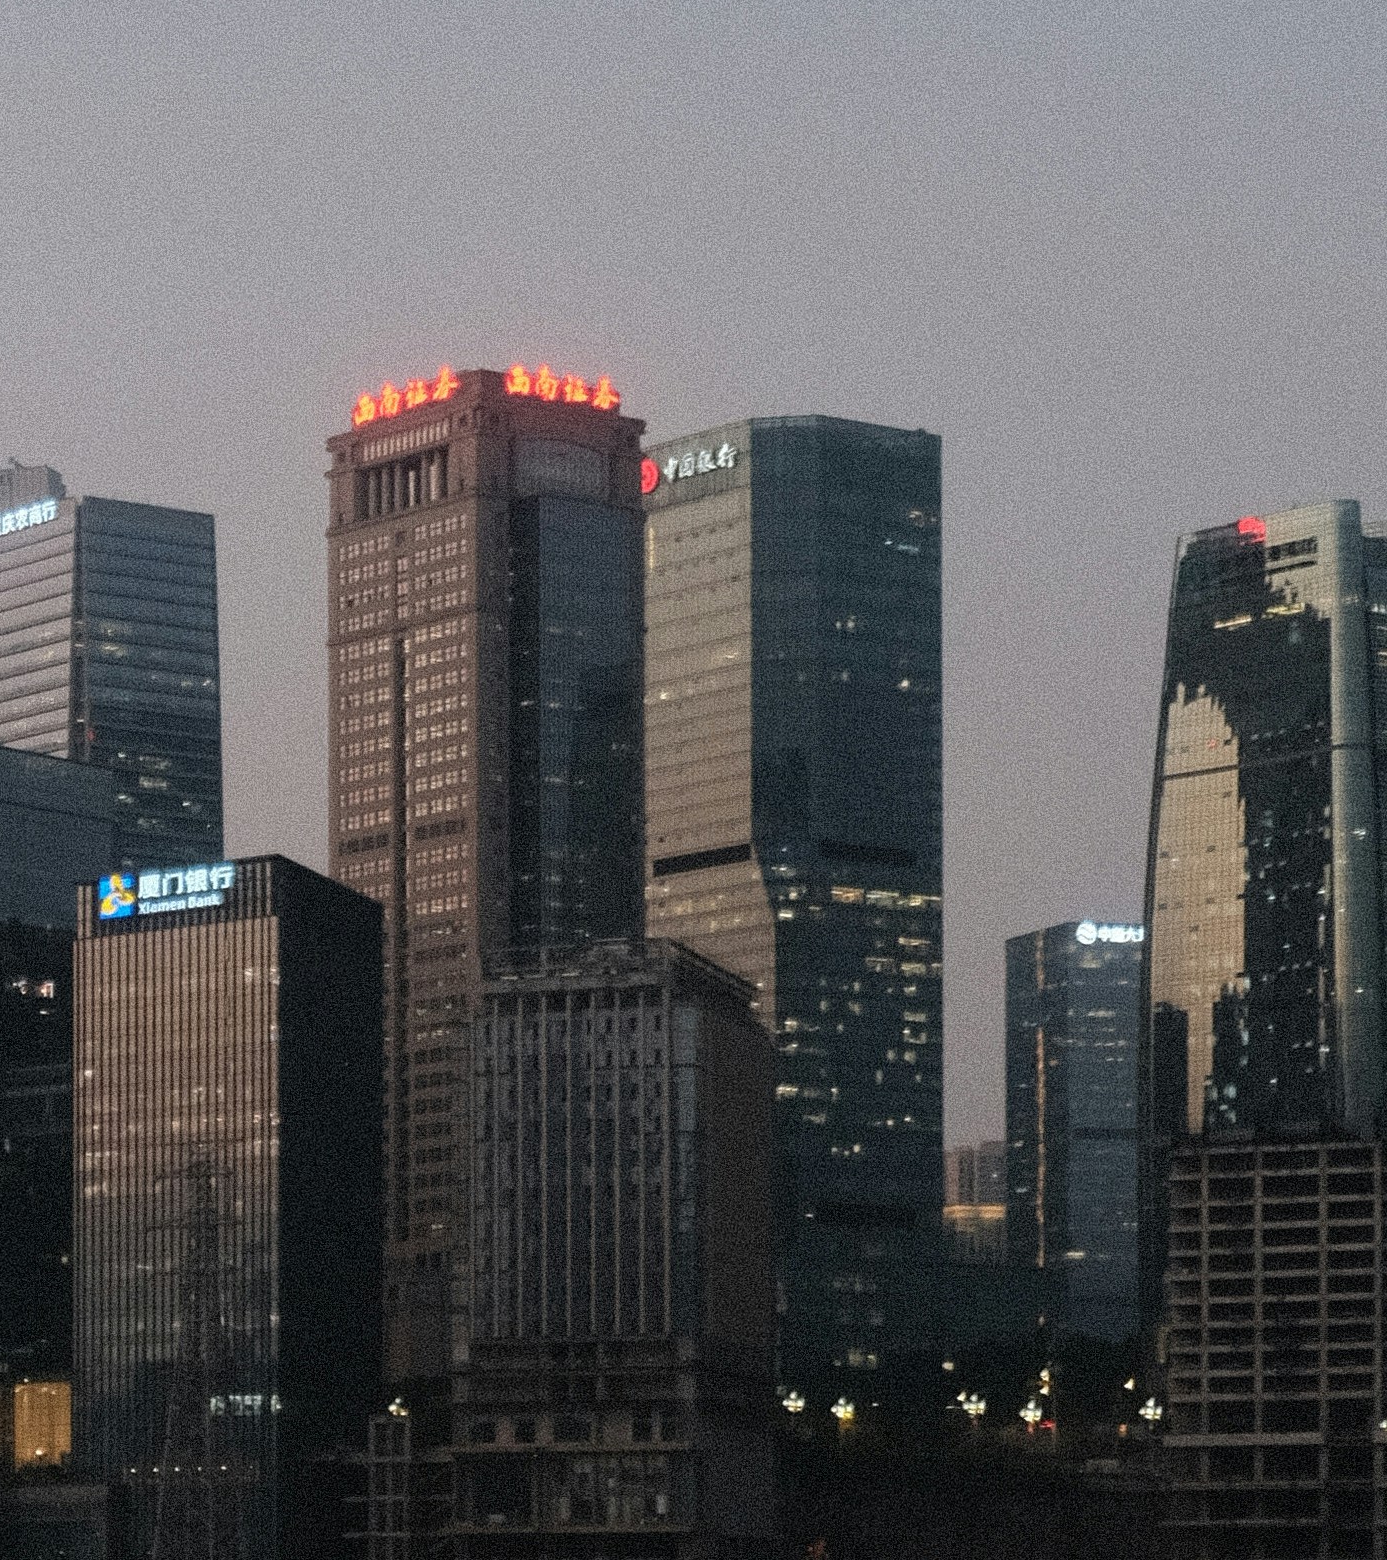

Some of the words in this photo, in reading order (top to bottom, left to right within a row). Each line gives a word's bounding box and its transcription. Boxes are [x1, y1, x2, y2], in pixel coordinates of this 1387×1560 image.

[138, 865, 233, 899] 厦门银行
[187, 893, 223, 909] Bank
